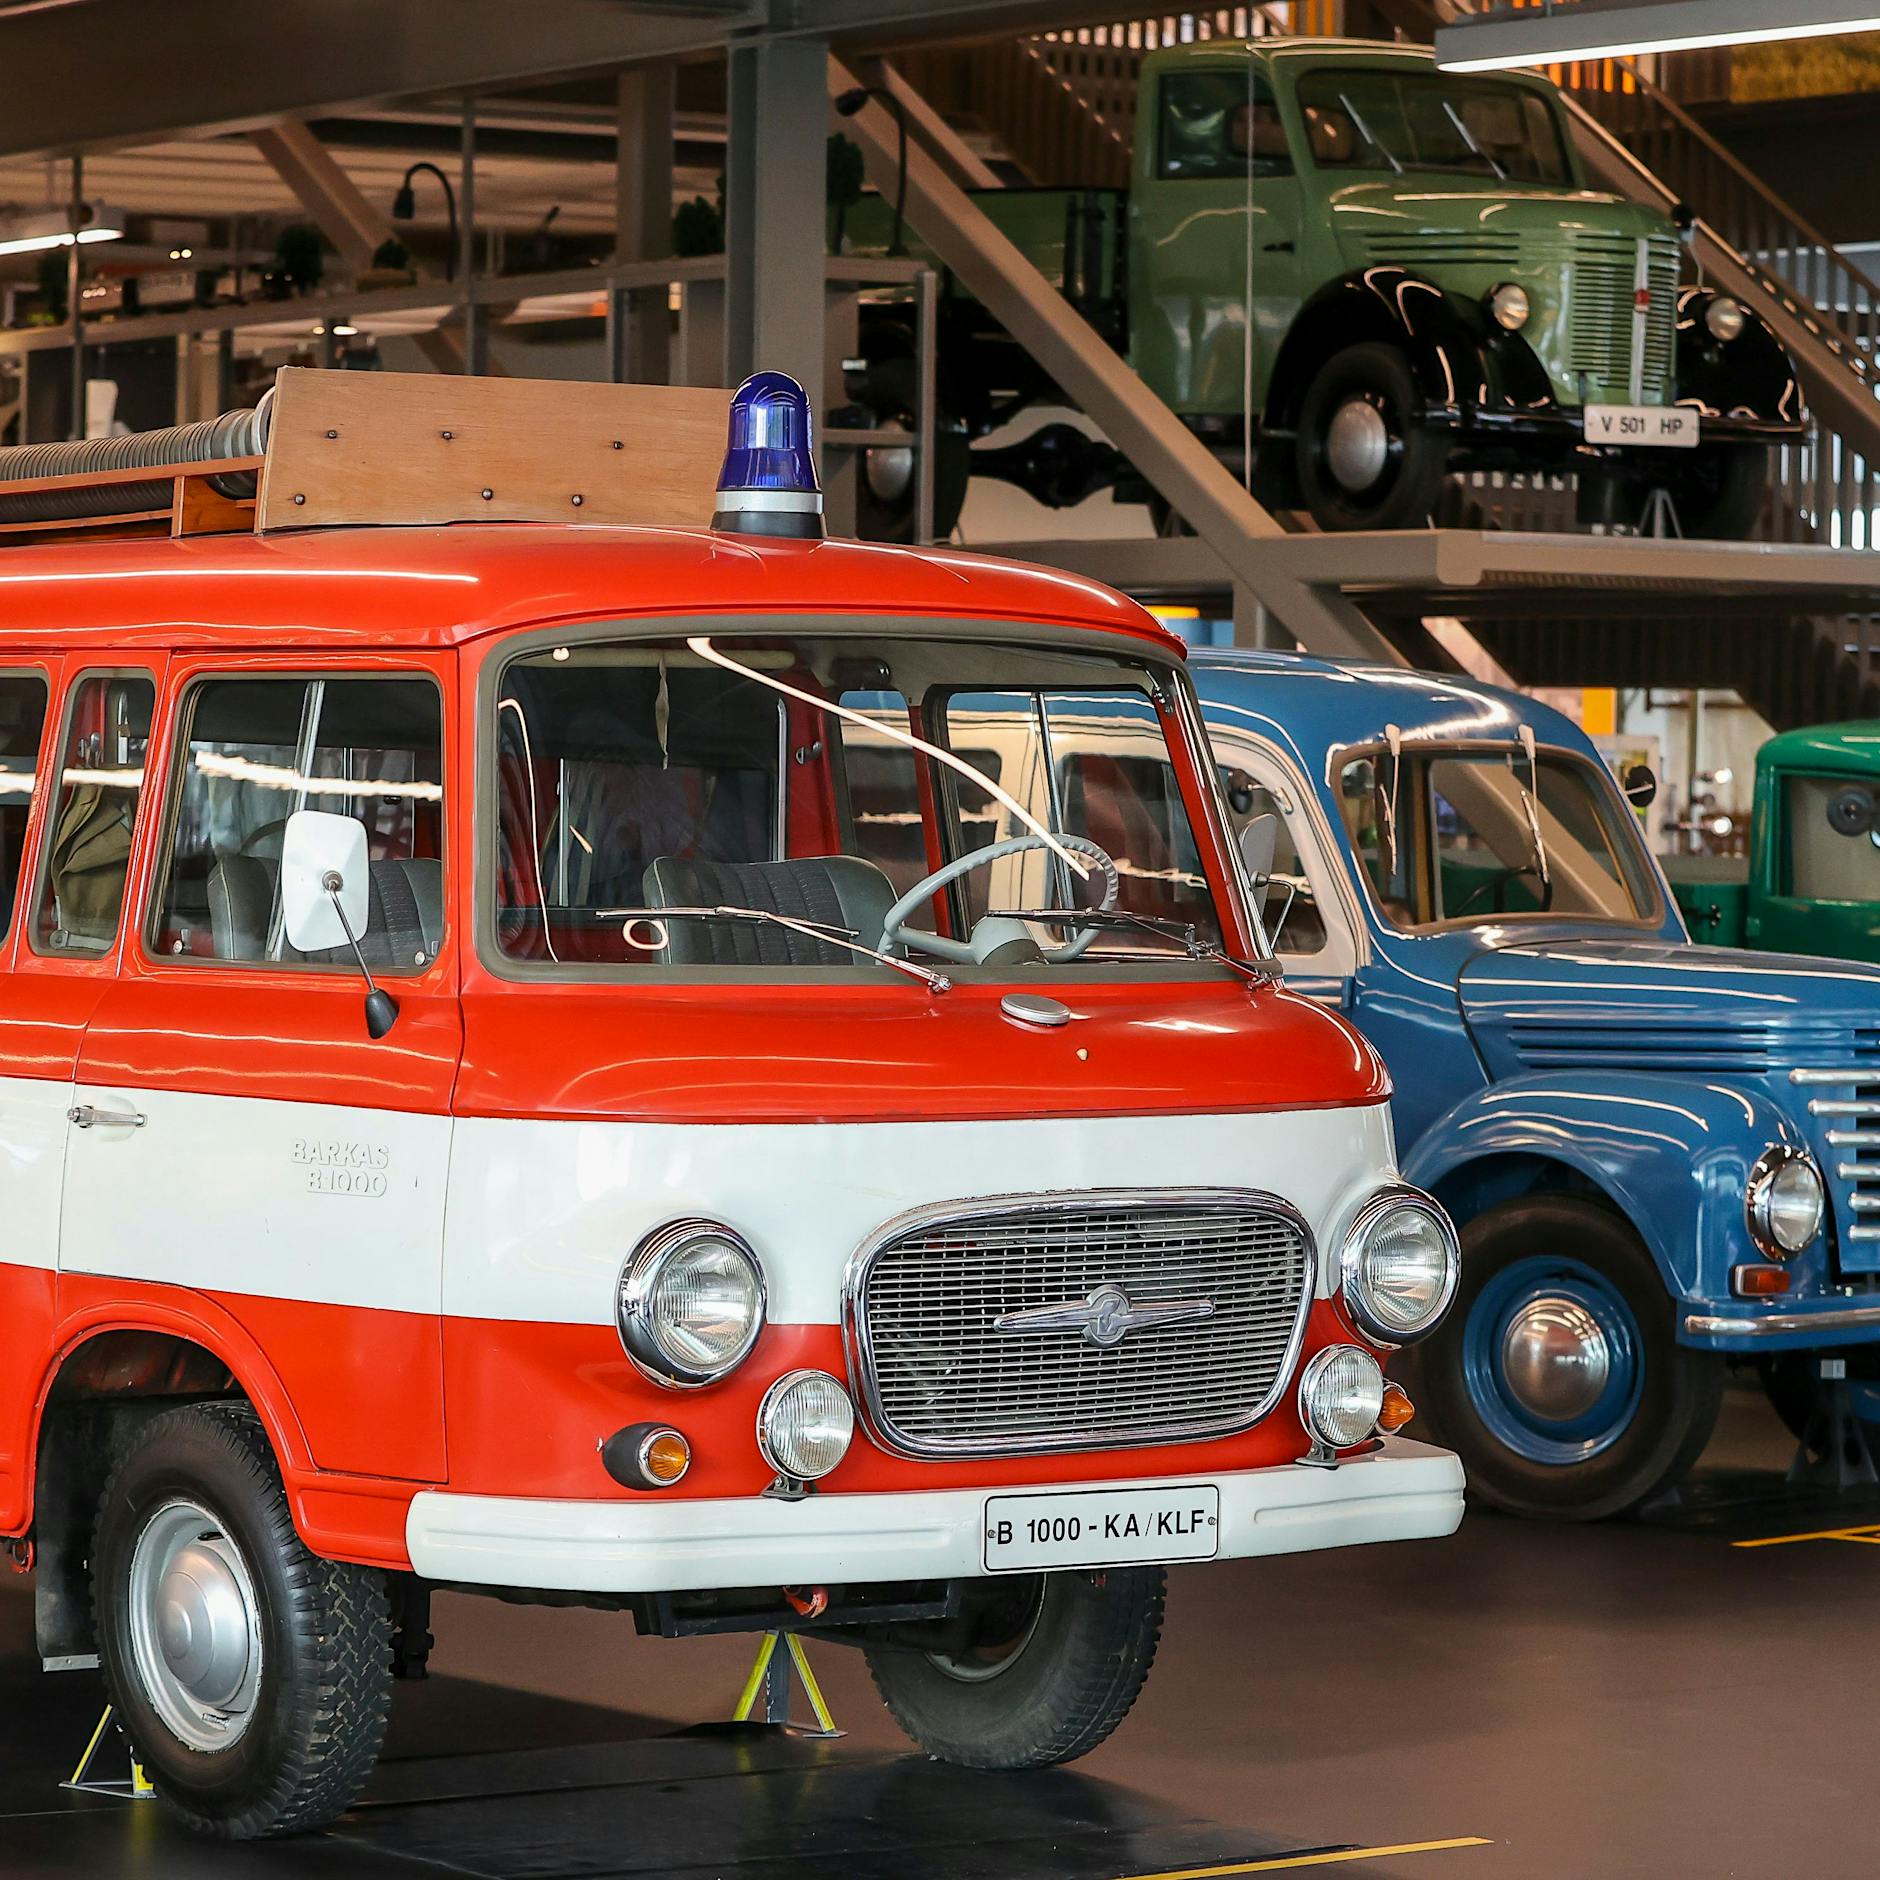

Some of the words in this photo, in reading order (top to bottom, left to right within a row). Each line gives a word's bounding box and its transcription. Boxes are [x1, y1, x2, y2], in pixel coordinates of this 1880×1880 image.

[1601, 416, 1612, 432] V
[1620, 416, 1645, 433] 501
[1661, 418, 1683, 434] HP
[291, 1138, 389, 1169] BARKAS
[997, 1520, 1013, 1545] B
